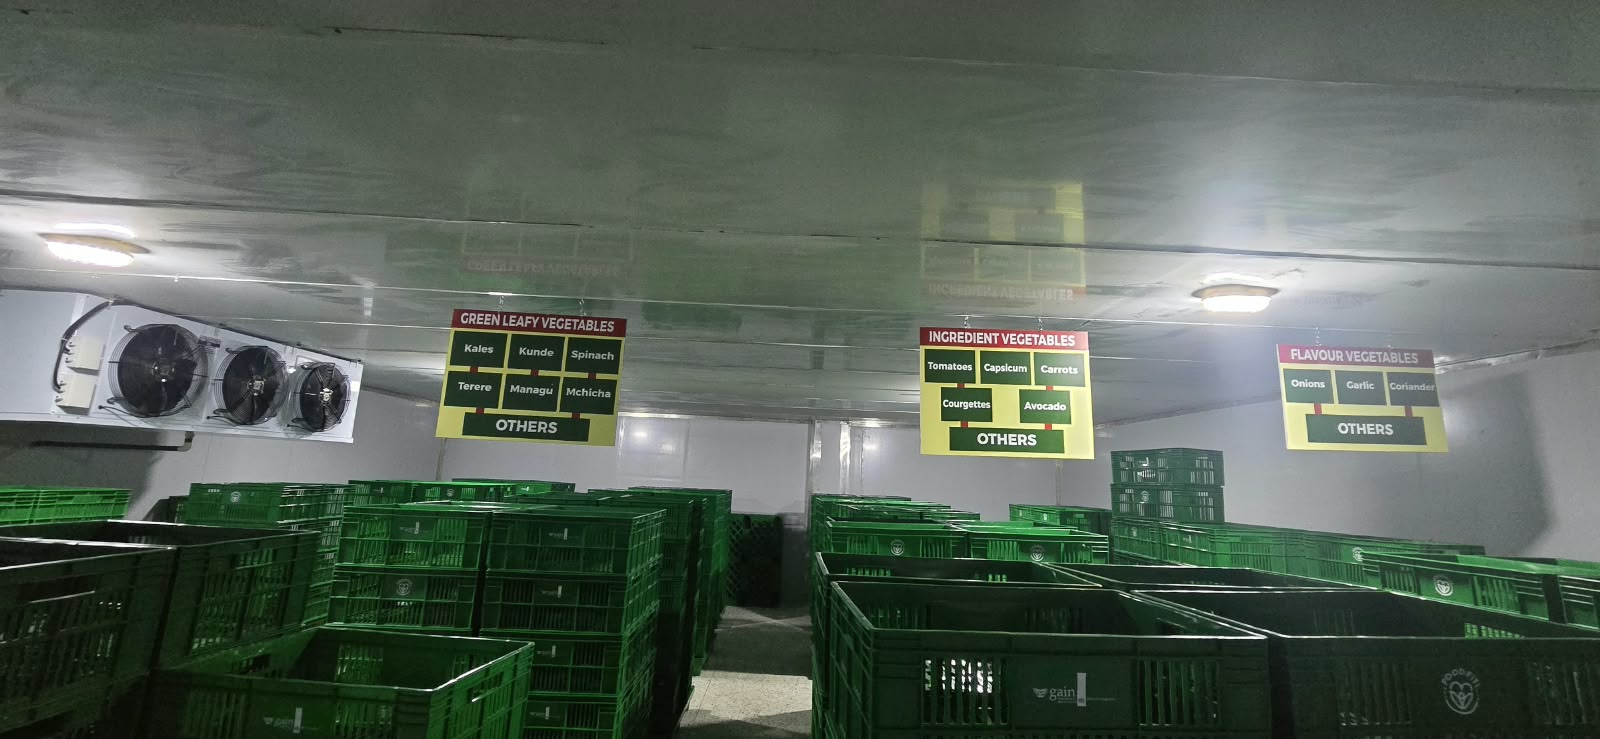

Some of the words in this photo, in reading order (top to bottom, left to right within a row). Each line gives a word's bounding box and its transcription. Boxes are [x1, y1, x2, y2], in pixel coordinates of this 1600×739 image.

[460, 312, 501, 326] GREEN
[502, 314, 540, 329] LEAFY
[541, 317, 615, 333] VEGETABLES
[929, 330, 1000, 345] INGREDIENT
[1001, 333, 1076, 347] VEGETABLES
[464, 343, 494, 354] Kales
[518, 346, 555, 357] Kunde
[571, 350, 615, 361] Spinach
[1290, 348, 1344, 362] FLAVOUR
[1345, 350, 1419, 364] VEGETABLES
[927, 361, 973, 371] Tomatoes
[983, 363, 1028, 374] Capsicum
[1040, 364, 1079, 375] Carrots
[458, 381, 492, 392] Terere
[1291, 379, 1326, 389] Onions
[1346, 380, 1375, 390] Garlic
[1389, 382, 1436, 391] Coriander
[509, 384, 554, 396] Managu
[566, 387, 611, 399] Mchicha
[942, 399, 991, 410] Courgettes
[1024, 401, 1067, 411] Avocado
[495, 419, 558, 434] OTHERS
[1337, 422, 1394, 436] OTHERS
[976, 432, 1037, 446] OTHERS
[1049, 685, 1076, 701] gain
